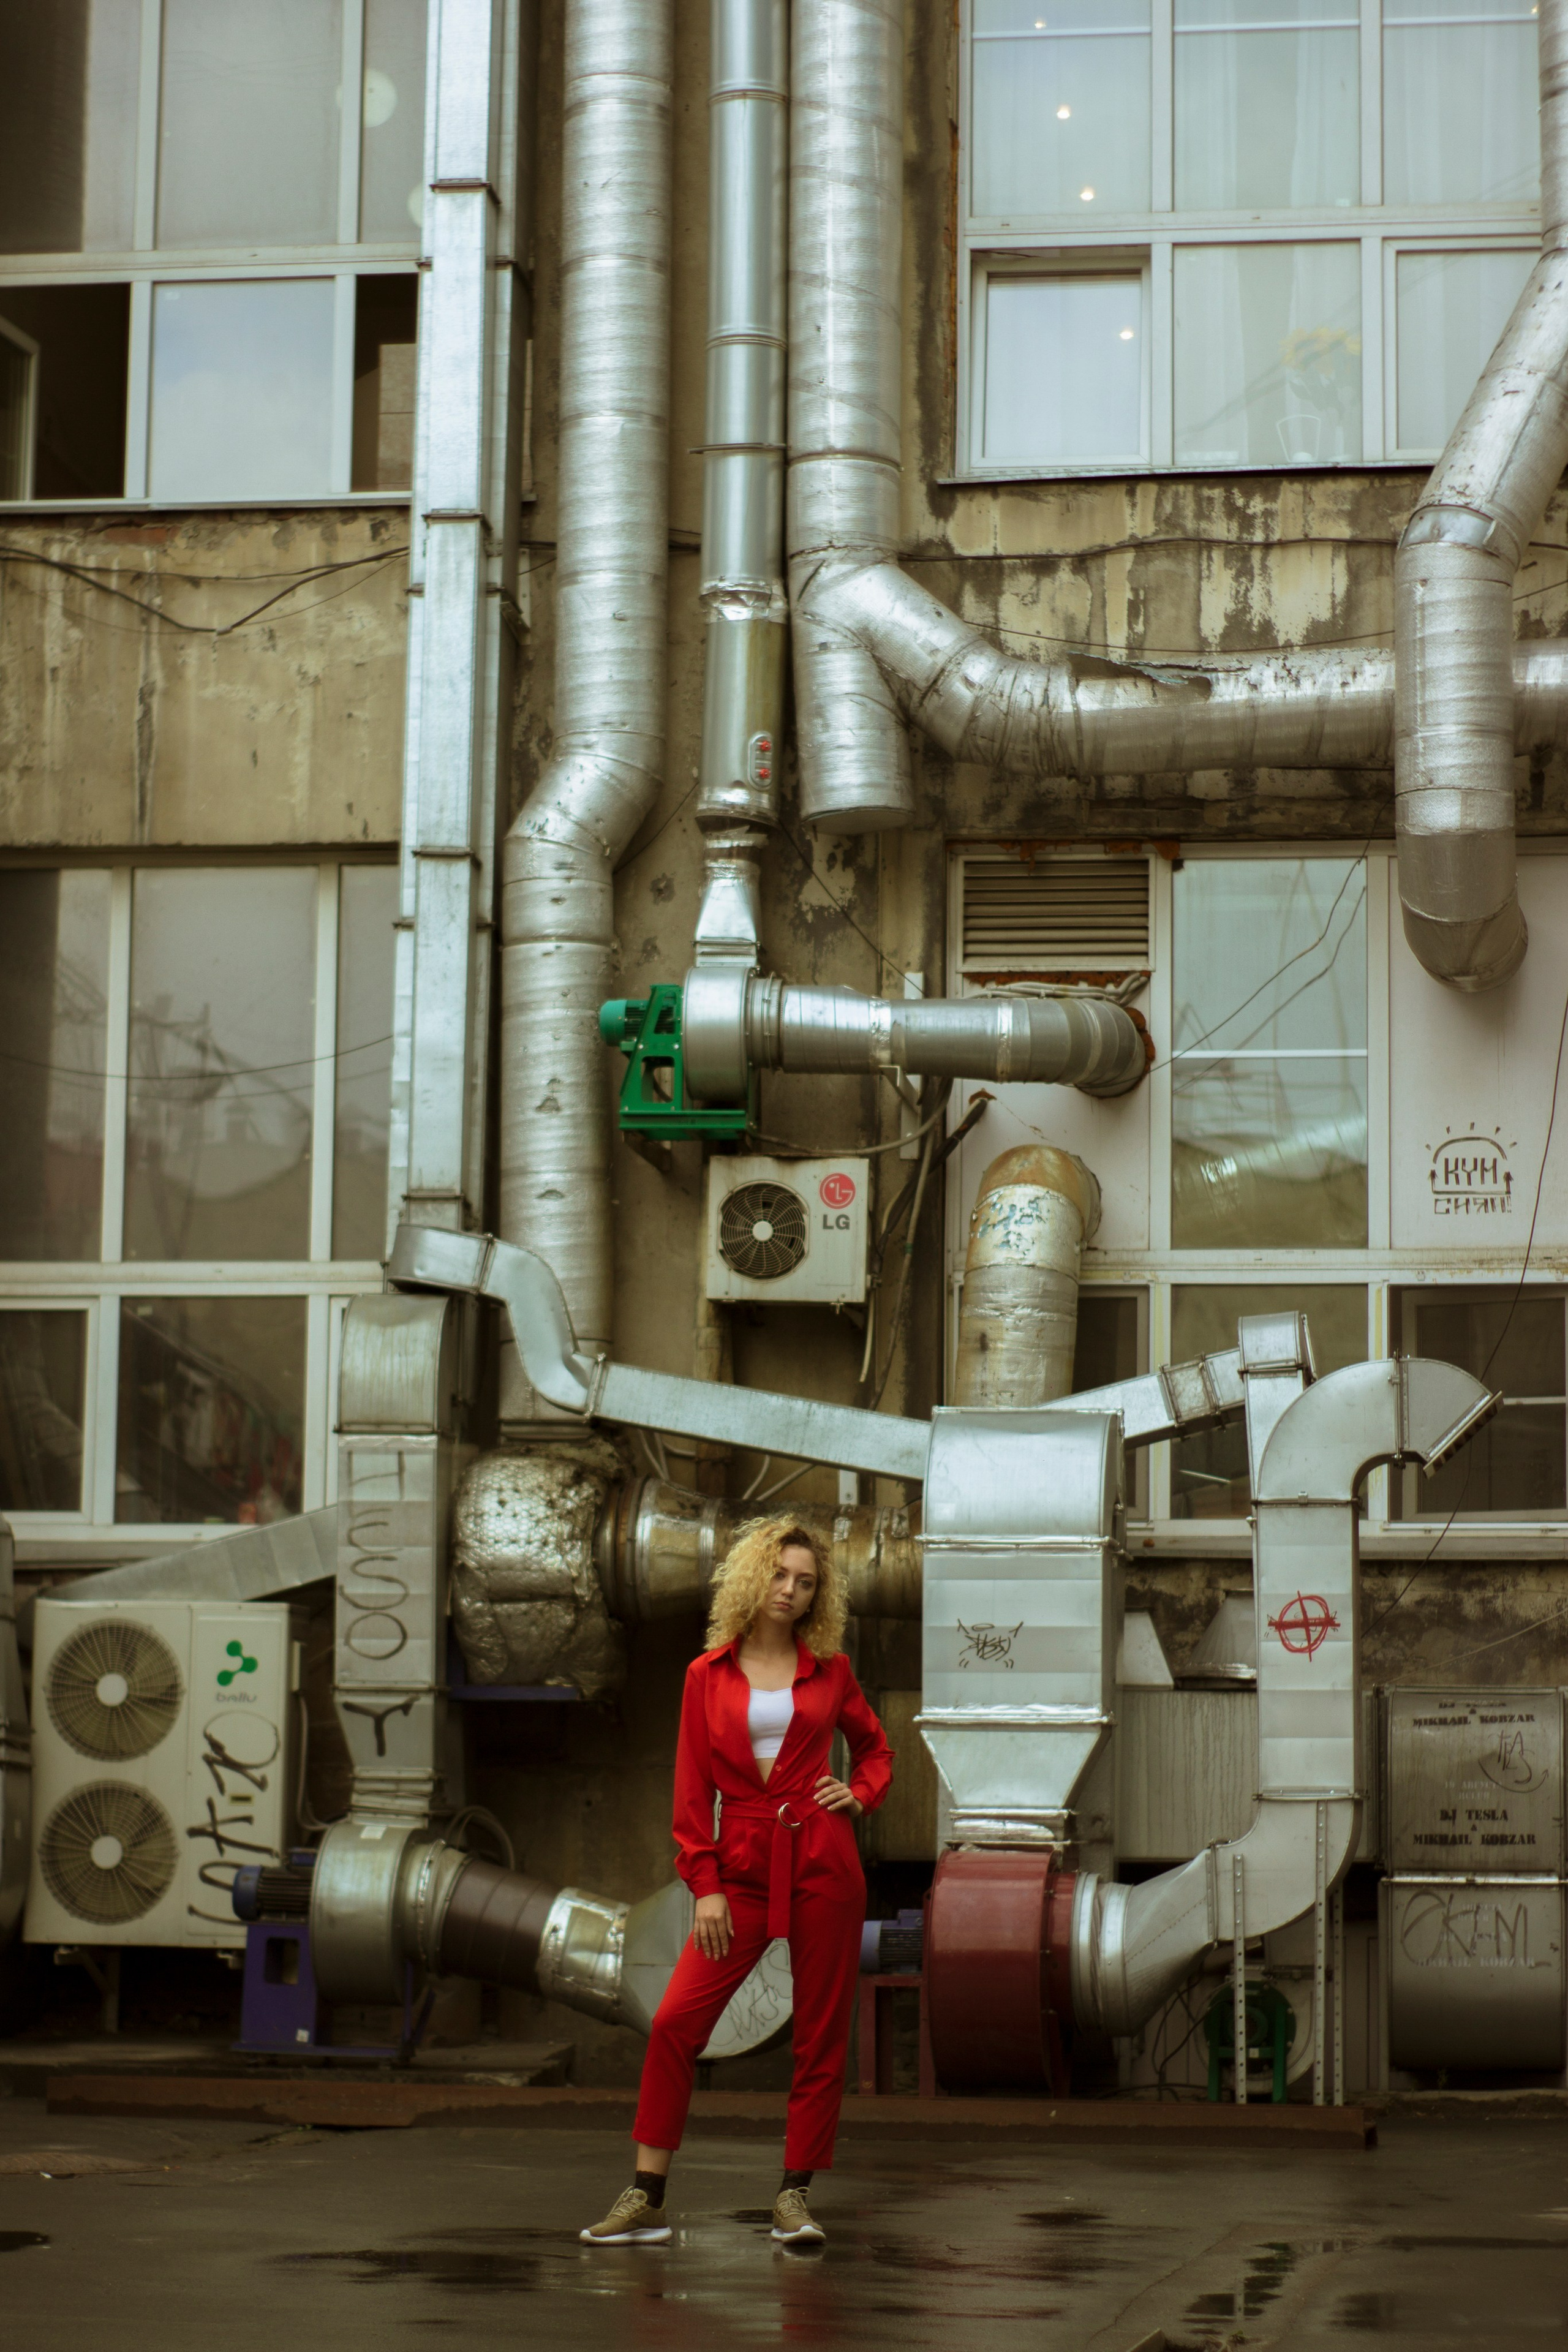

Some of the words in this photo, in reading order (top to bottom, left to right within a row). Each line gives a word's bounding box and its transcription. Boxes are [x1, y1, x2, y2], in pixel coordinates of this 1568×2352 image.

[822, 1214, 850, 1230] LG
[216, 1692, 258, 1702] ballu
[1413, 1716, 1471, 1727] MIKHAIL
[1479, 1714, 1536, 1724] KOBZAR
[1440, 1809, 1457, 1822] DJ
[1466, 1809, 1509, 1822] TESLA
[1413, 1834, 1472, 1845] MIKHAIL
[1480, 1834, 1536, 1845] KOBZAR
